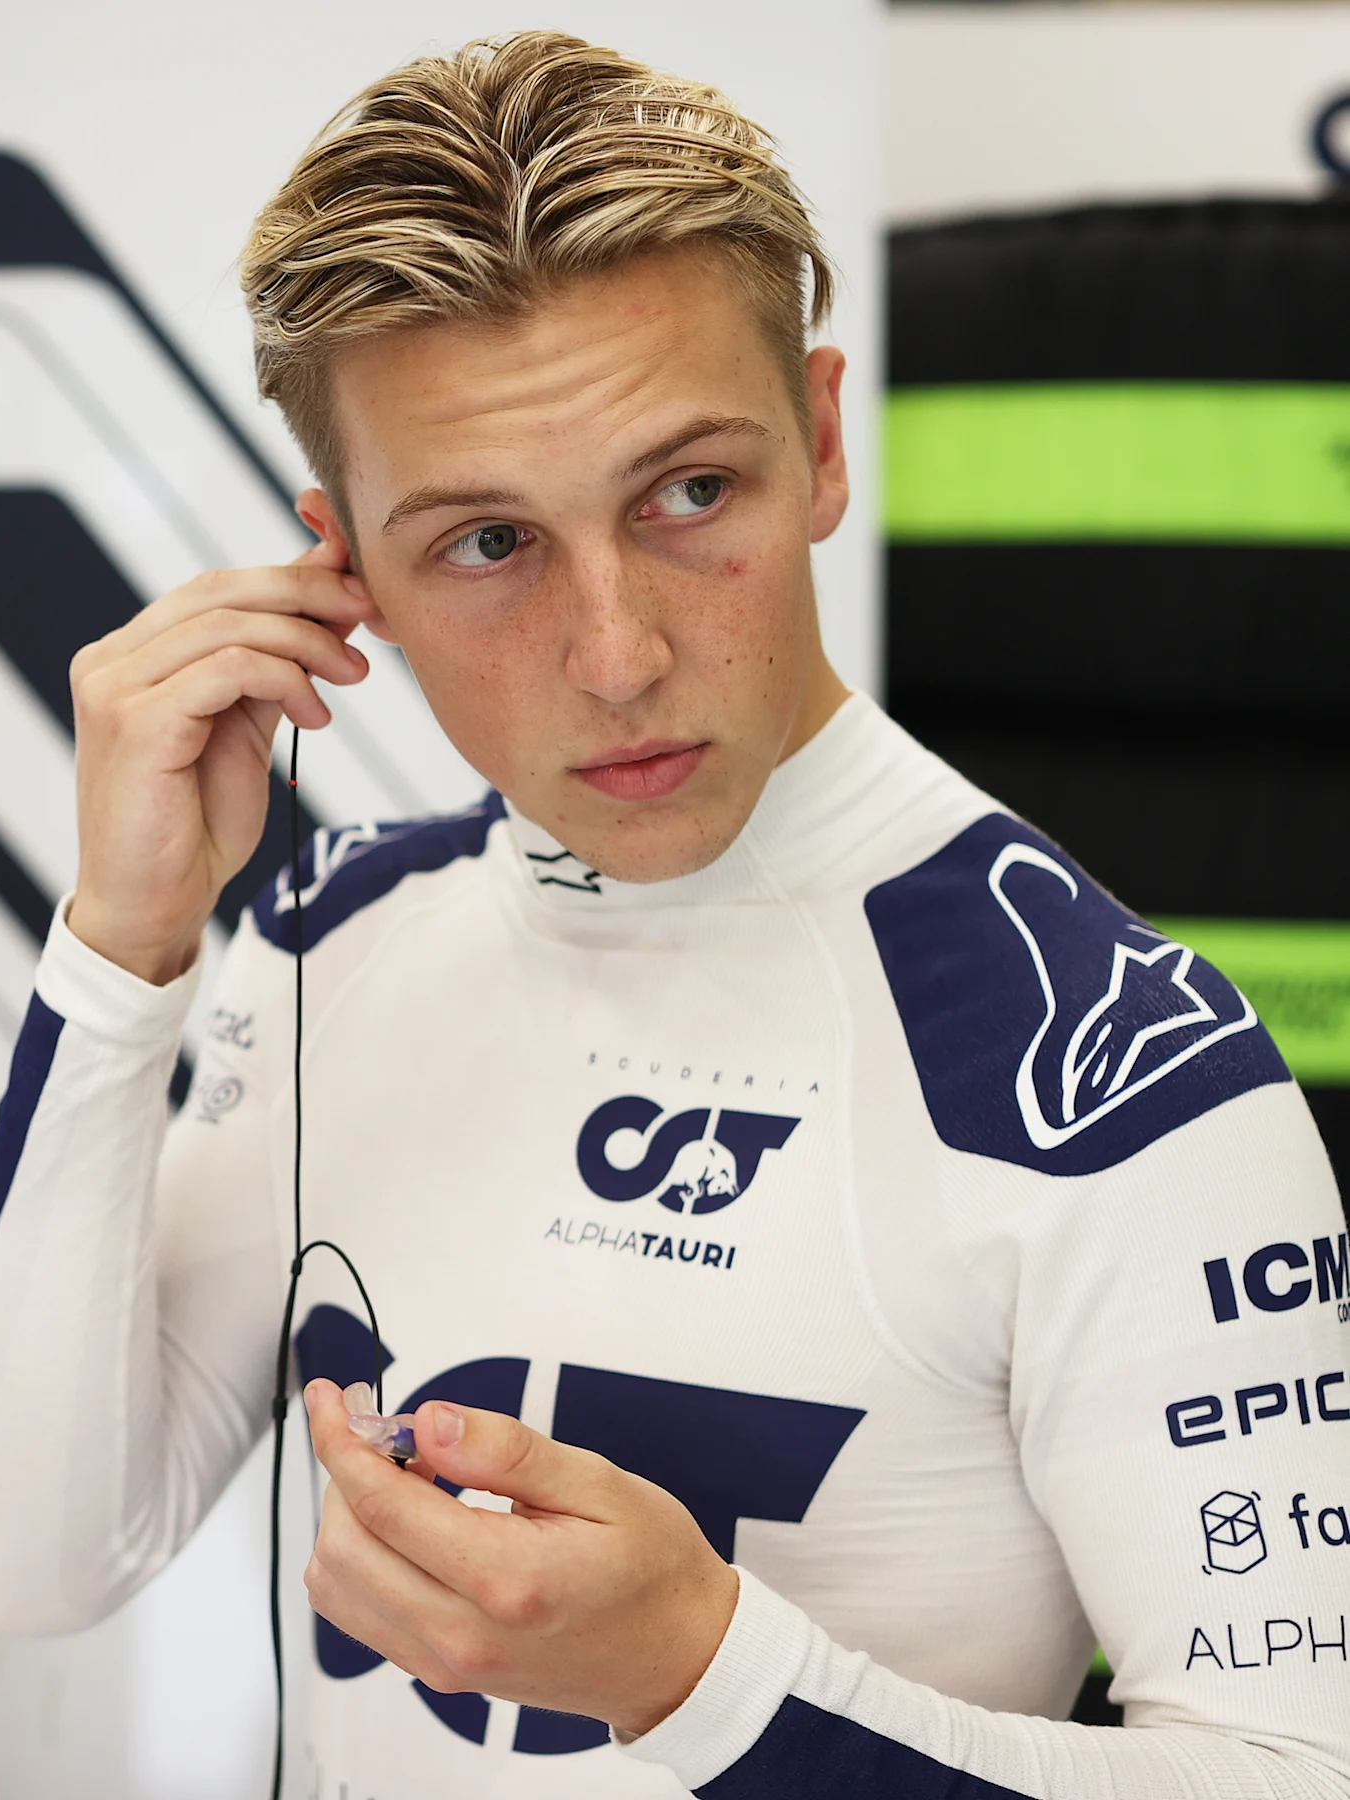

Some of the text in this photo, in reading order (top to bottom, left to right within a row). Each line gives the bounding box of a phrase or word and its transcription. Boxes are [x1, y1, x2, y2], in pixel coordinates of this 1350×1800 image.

[587, 1051, 821, 1094] SCUDERIA
[544, 1216, 737, 1270] ALPHATAURI
[1203, 1233, 1350, 1324] ICM
[1288, 1493, 1350, 1549] fa
[1186, 1615, 1347, 1671] ALPH
